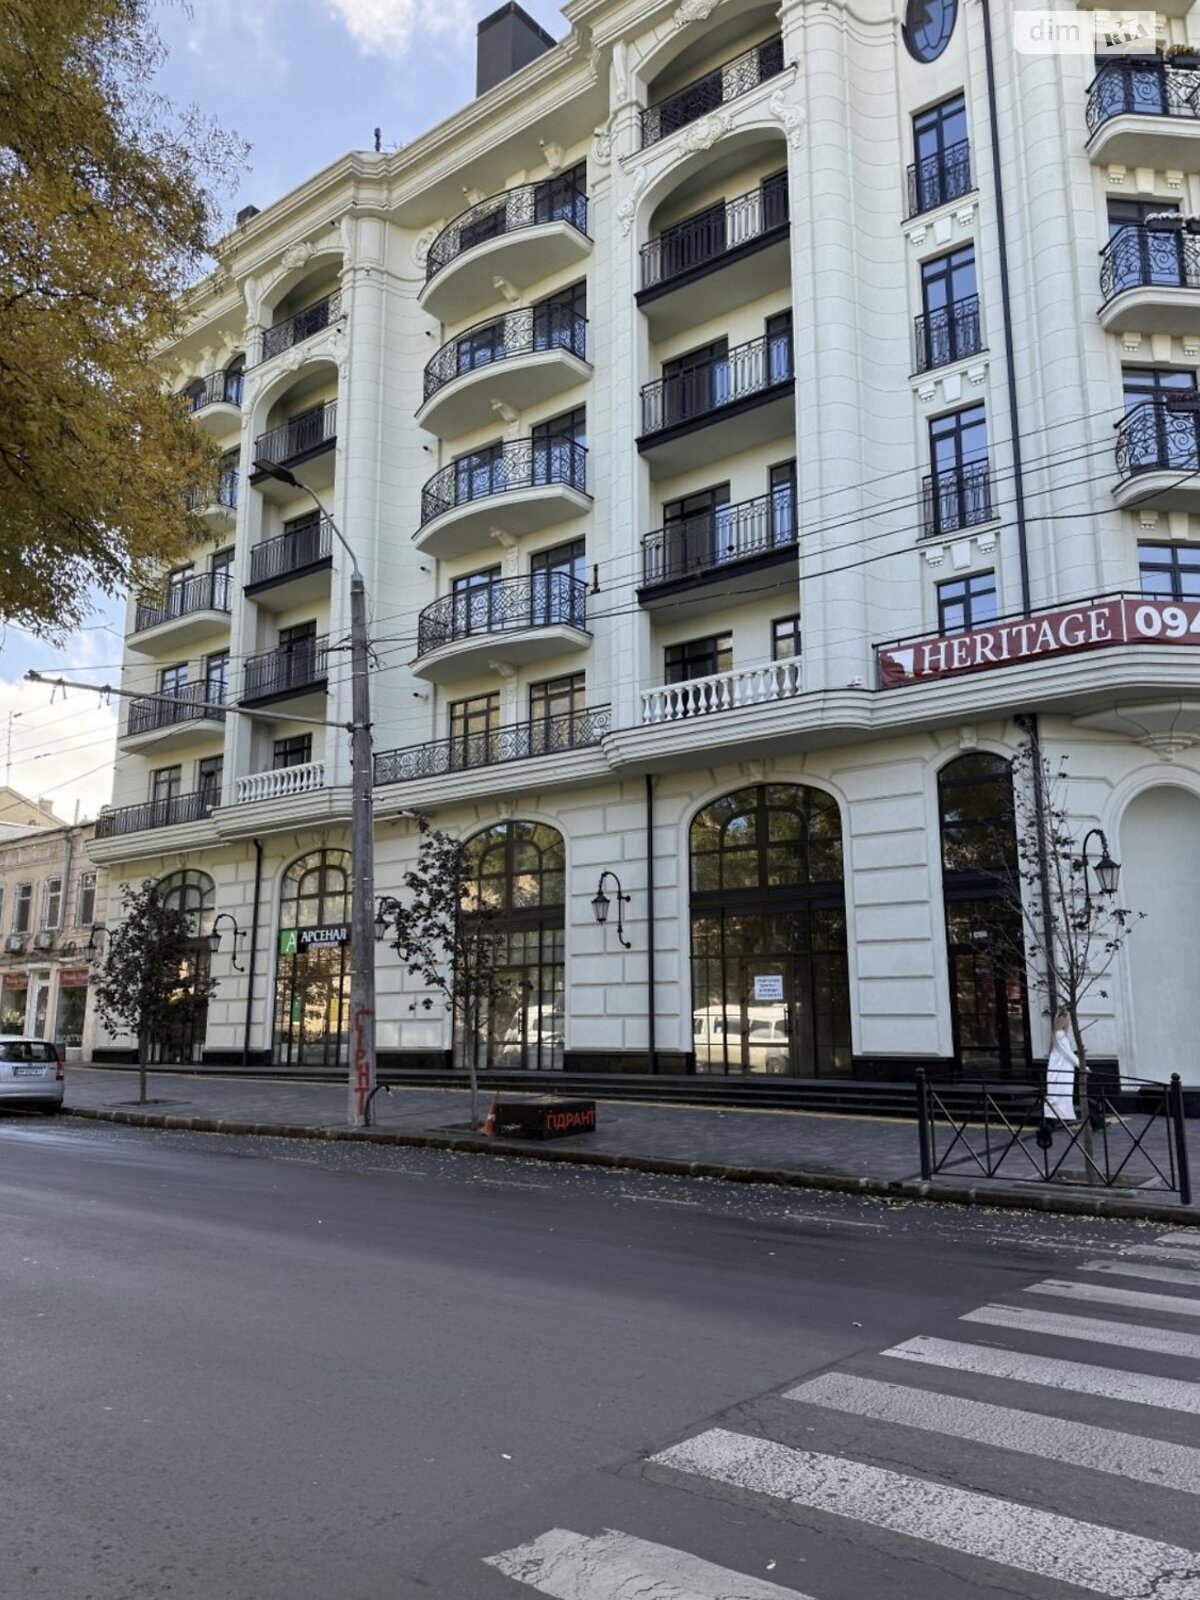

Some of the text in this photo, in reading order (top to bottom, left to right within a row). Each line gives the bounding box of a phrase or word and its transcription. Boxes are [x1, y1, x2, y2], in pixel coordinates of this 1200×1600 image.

[921, 607, 1112, 675] HERITAGE
[300, 927, 347, 943] АРСЕНАЛ
[547, 1109, 595, 1130] ГІДРАНТ
